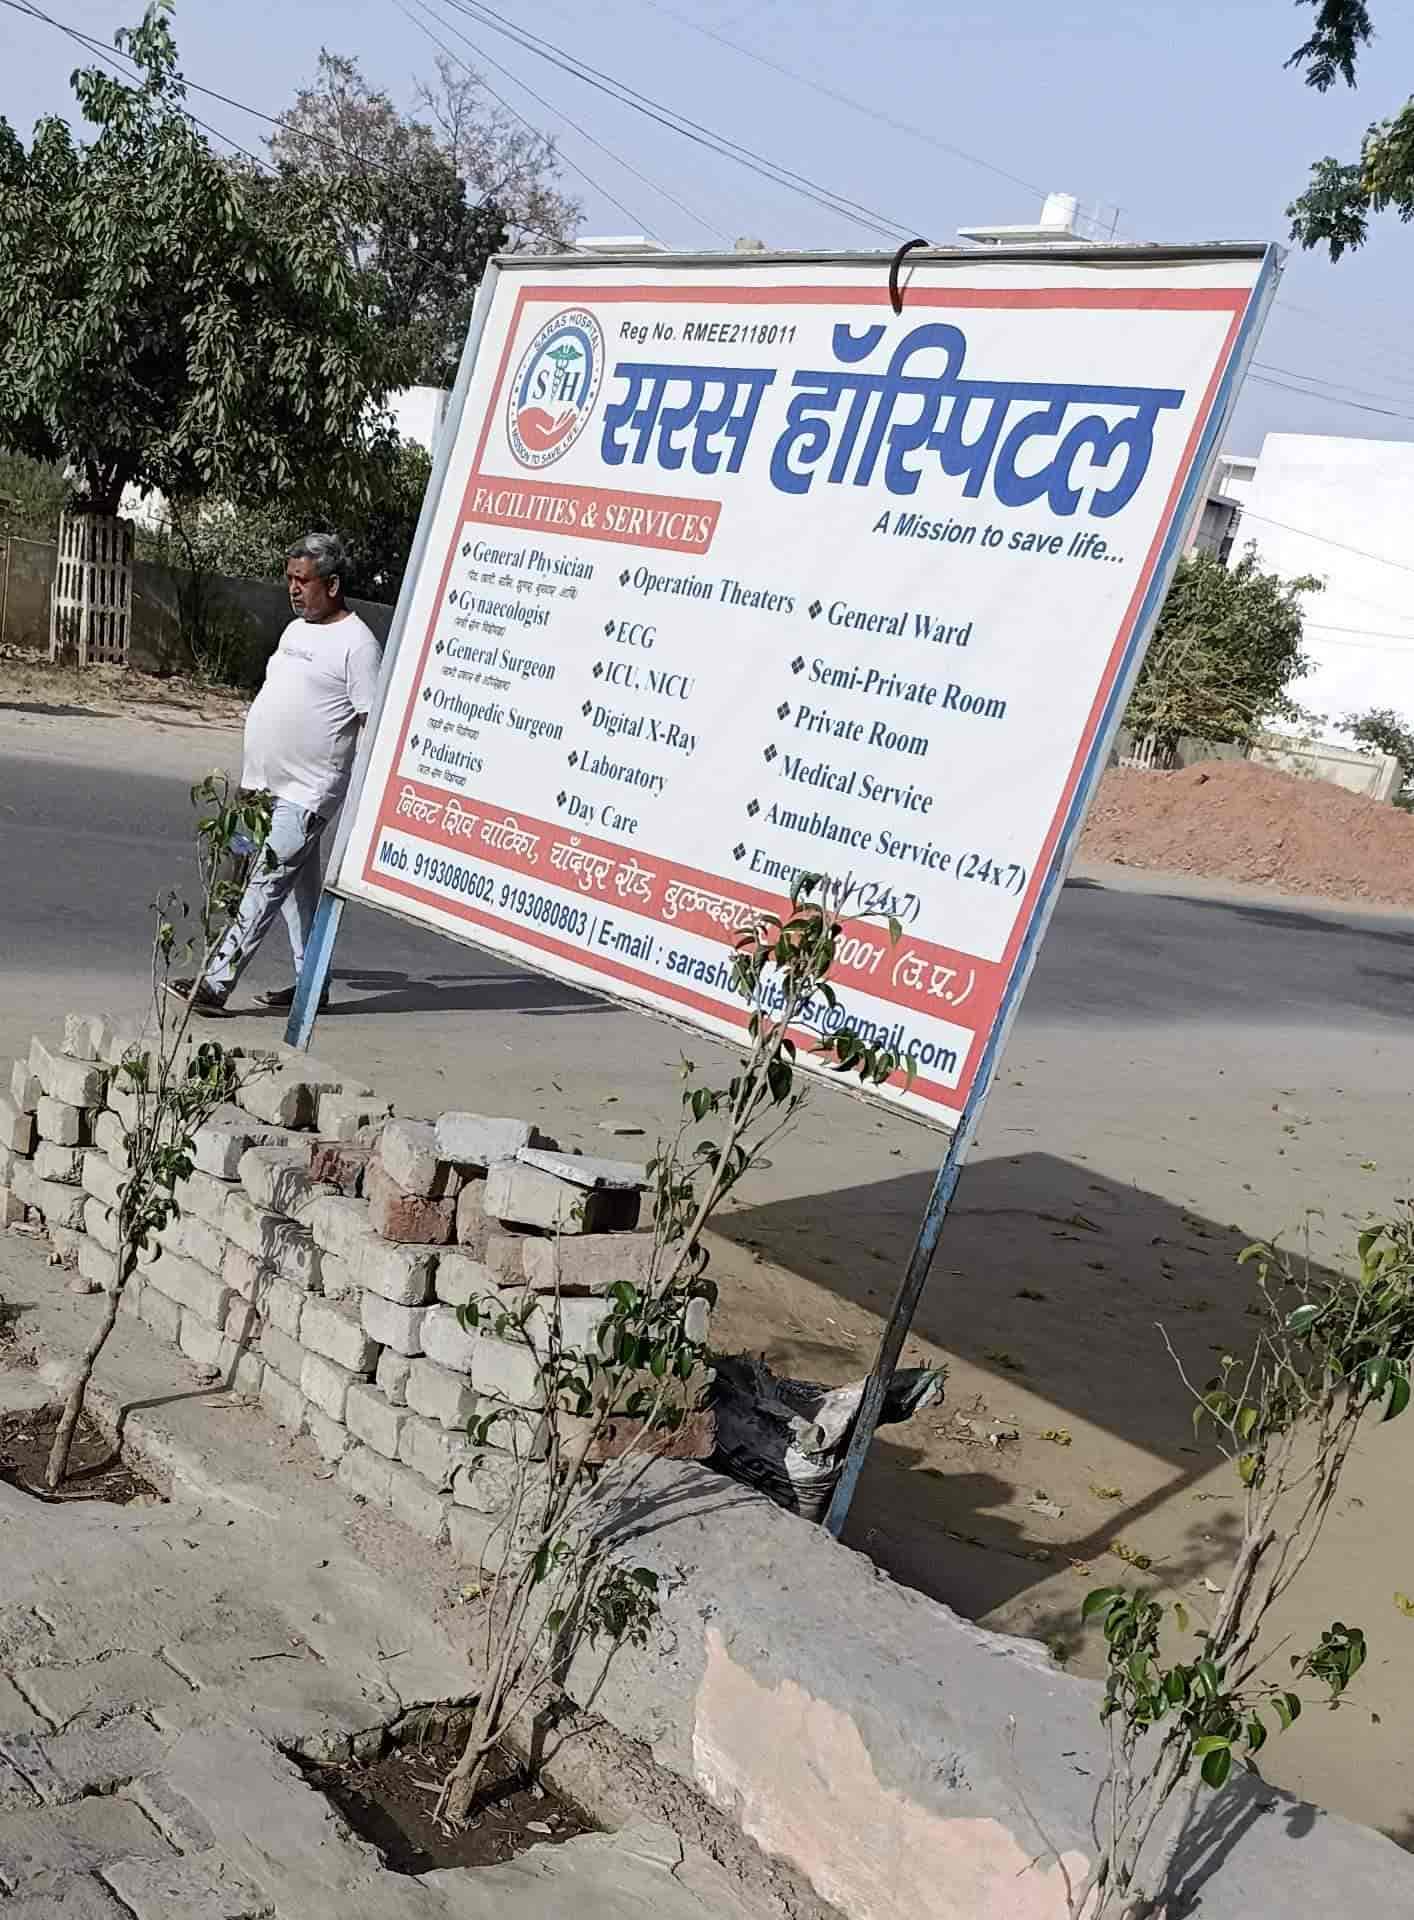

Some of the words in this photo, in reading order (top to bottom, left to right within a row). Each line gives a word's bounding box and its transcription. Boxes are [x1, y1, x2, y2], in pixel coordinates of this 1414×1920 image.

[534, 316, 567, 351] SARAS
[568, 313, 600, 352] HOSPITAL
[619, 321, 648, 344] Reg
[652, 322, 677, 341] No.
[682, 322, 798, 344] RMEE2118011
[532, 368, 550, 400] S
[558, 371, 580, 401] H
[600, 362, 777, 475] सरस
[769, 322, 1187, 518] हॉस्पिटल
[471, 487, 578, 526] FACILITIES
[581, 501, 600, 529] &
[601, 503, 713, 545] SERVICES
[872, 510, 891, 534] A
[892, 512, 977, 545] Mission
[980, 524, 1004, 548] to
[1007, 529, 1065, 555] save
[1067, 532, 1125, 563] life...
[473, 541, 527, 569] General
[527, 549, 594, 580] Physician
[459, 590, 551, 629] Gynaecologist
[633, 566, 713, 600] Operation
[719, 578, 797, 614] Theaters
[616, 621, 658, 649] ECG
[827, 600, 909, 637] General
[913, 612, 973, 647] Ward
[446, 637, 499, 666] General
[499, 649, 556, 680] Surgeon
[646, 669, 696, 700] NICU
[808, 657, 938, 706] Semi-Private
[941, 683, 1008, 719] Room
[433, 688, 505, 725] Orthopedic
[506, 707, 564, 740] Surgeon
[592, 706, 645, 738] Digital
[646, 718, 699, 757] X-Ray
[794, 704, 865, 742] Private
[867, 720, 930, 757] Room
[422, 737, 484, 773] Pediatrics
[579, 749, 668, 797] Laboratory
[779, 754, 857, 796] Medical
[858, 774, 934, 815] Service
[396, 784, 443, 825] निकट
[440, 798, 479, 839] शिव
[480, 816, 541, 865] वाटिका,
[550, 836, 617, 892] चाँदपुर
[568, 794, 597, 826] Day
[600, 805, 639, 835] Care
[764, 801, 873, 851] Amublance
[875, 830, 952, 872] Service
[955, 852, 1027, 897] (24x7)
[379, 840, 409, 873] Mob.
[413, 852, 496, 906] 9193080602,
[499, 884, 588, 937] 9193080803
[598, 920, 655, 962] E-mail
[856, 882, 921, 924] (24x7)
